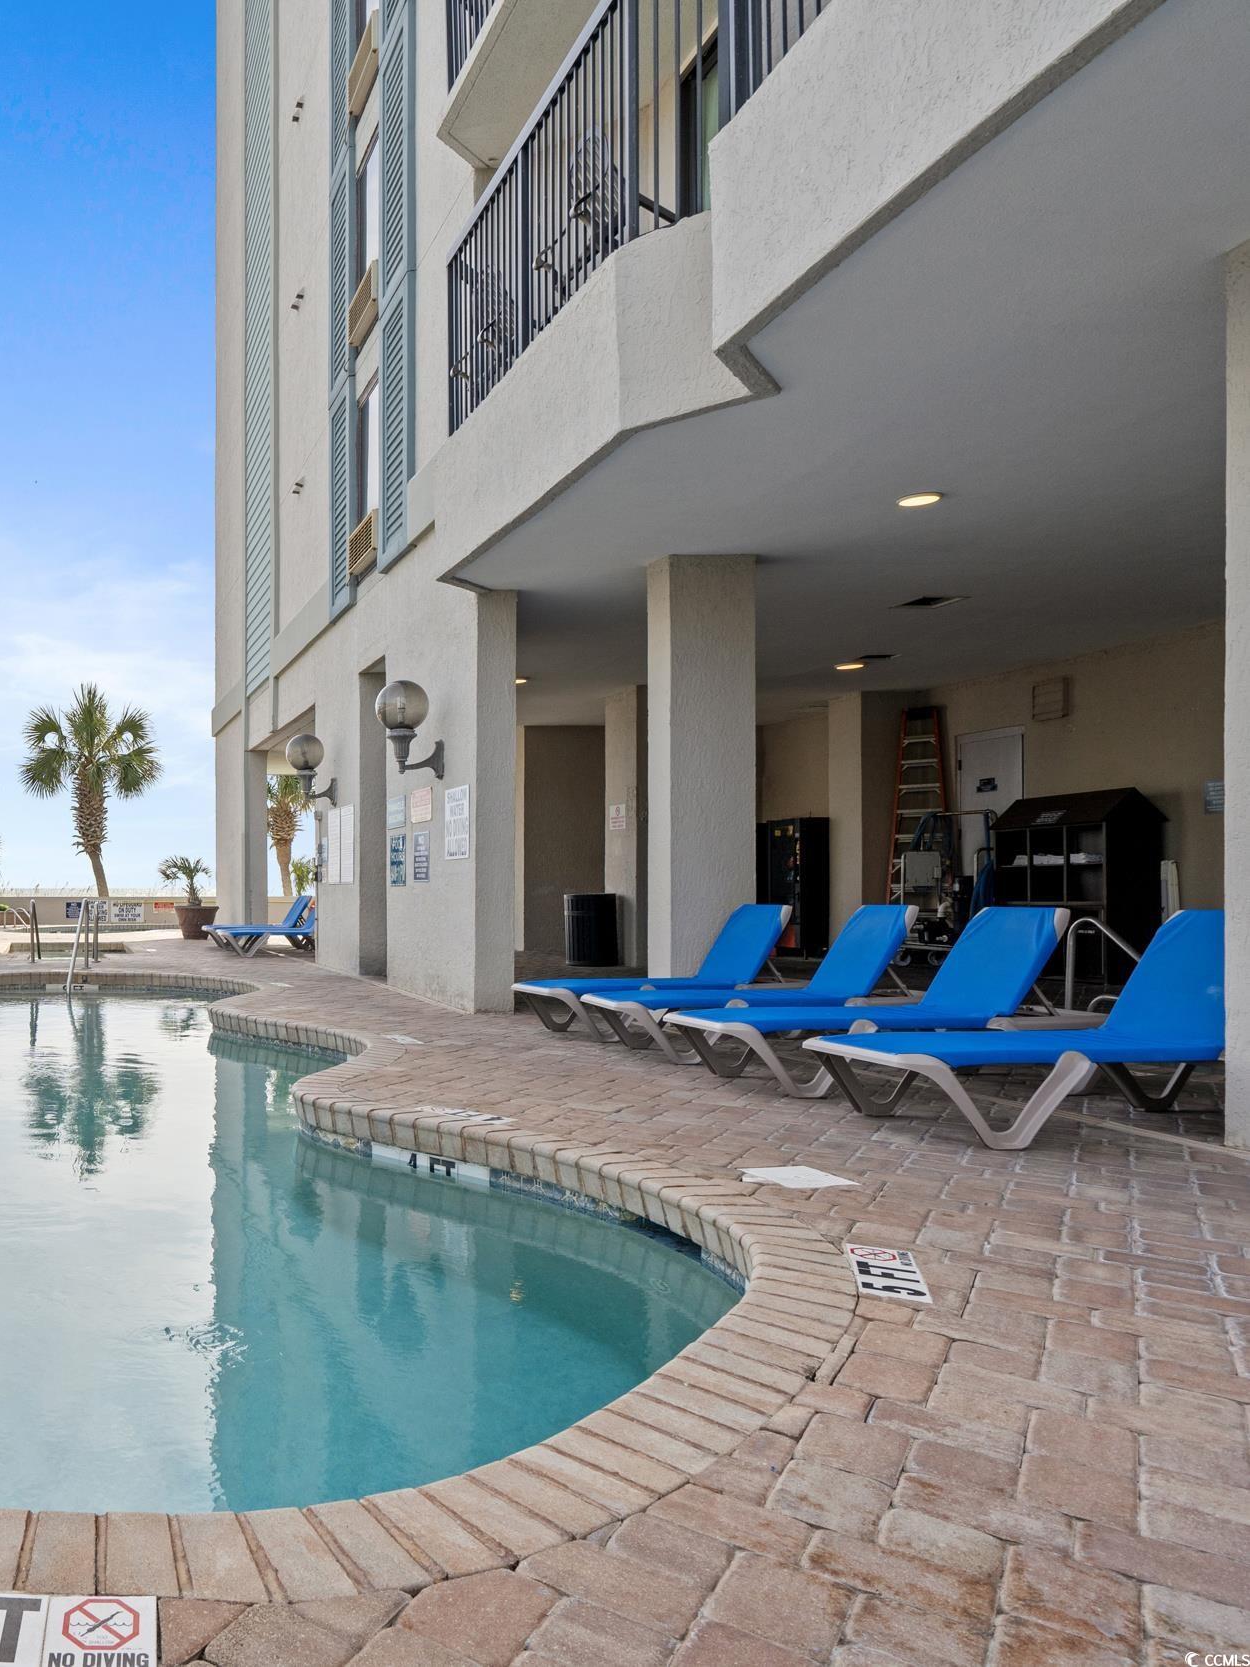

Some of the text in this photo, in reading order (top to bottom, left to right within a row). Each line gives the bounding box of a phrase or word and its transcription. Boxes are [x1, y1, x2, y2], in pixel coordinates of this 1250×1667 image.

[429, 1157, 456, 1177] FT
[856, 1261, 926, 1296] 5 FT
[48, 1652, 150, 1667] NO DIVING
